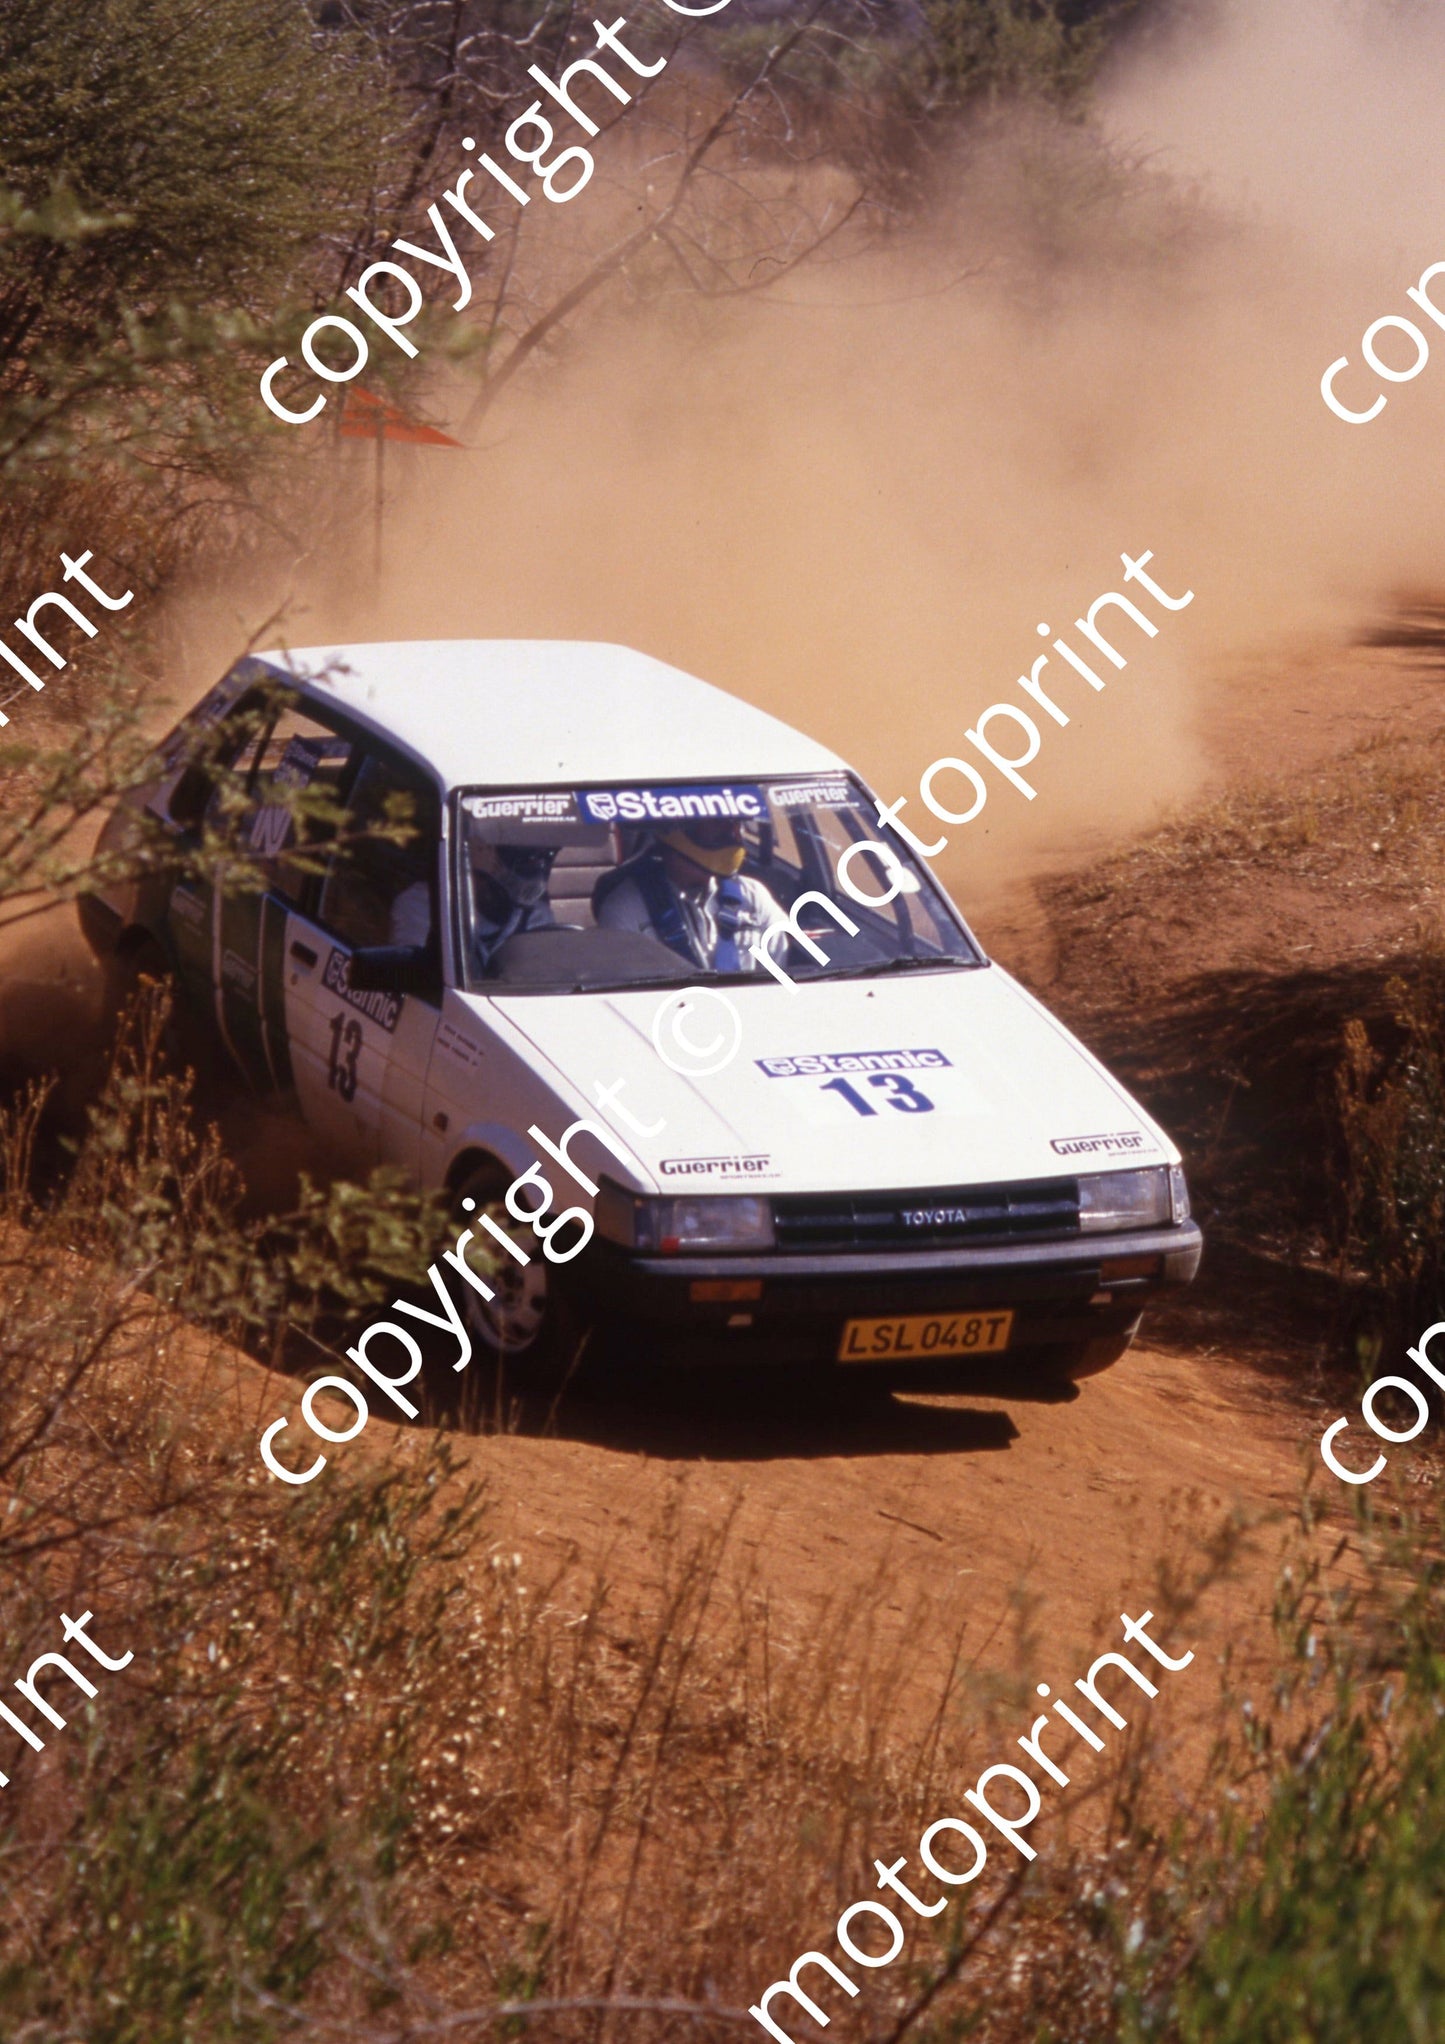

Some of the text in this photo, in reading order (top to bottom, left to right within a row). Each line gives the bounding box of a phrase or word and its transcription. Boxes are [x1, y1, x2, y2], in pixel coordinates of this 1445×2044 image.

[471, 793, 572, 819] Guerrier
[616, 789, 761, 819] Stannic
[768, 780, 850, 807] Guerrier
[336, 957, 398, 1028] Sannic
[328, 1012, 362, 1103] 13
[793, 1050, 944, 1074] Stannic
[819, 1073, 935, 1116] 13
[1049, 1131, 1143, 1155] Guerrier
[659, 1154, 771, 1175] Guerrier
[902, 1209, 967, 1225] TOYOTA
